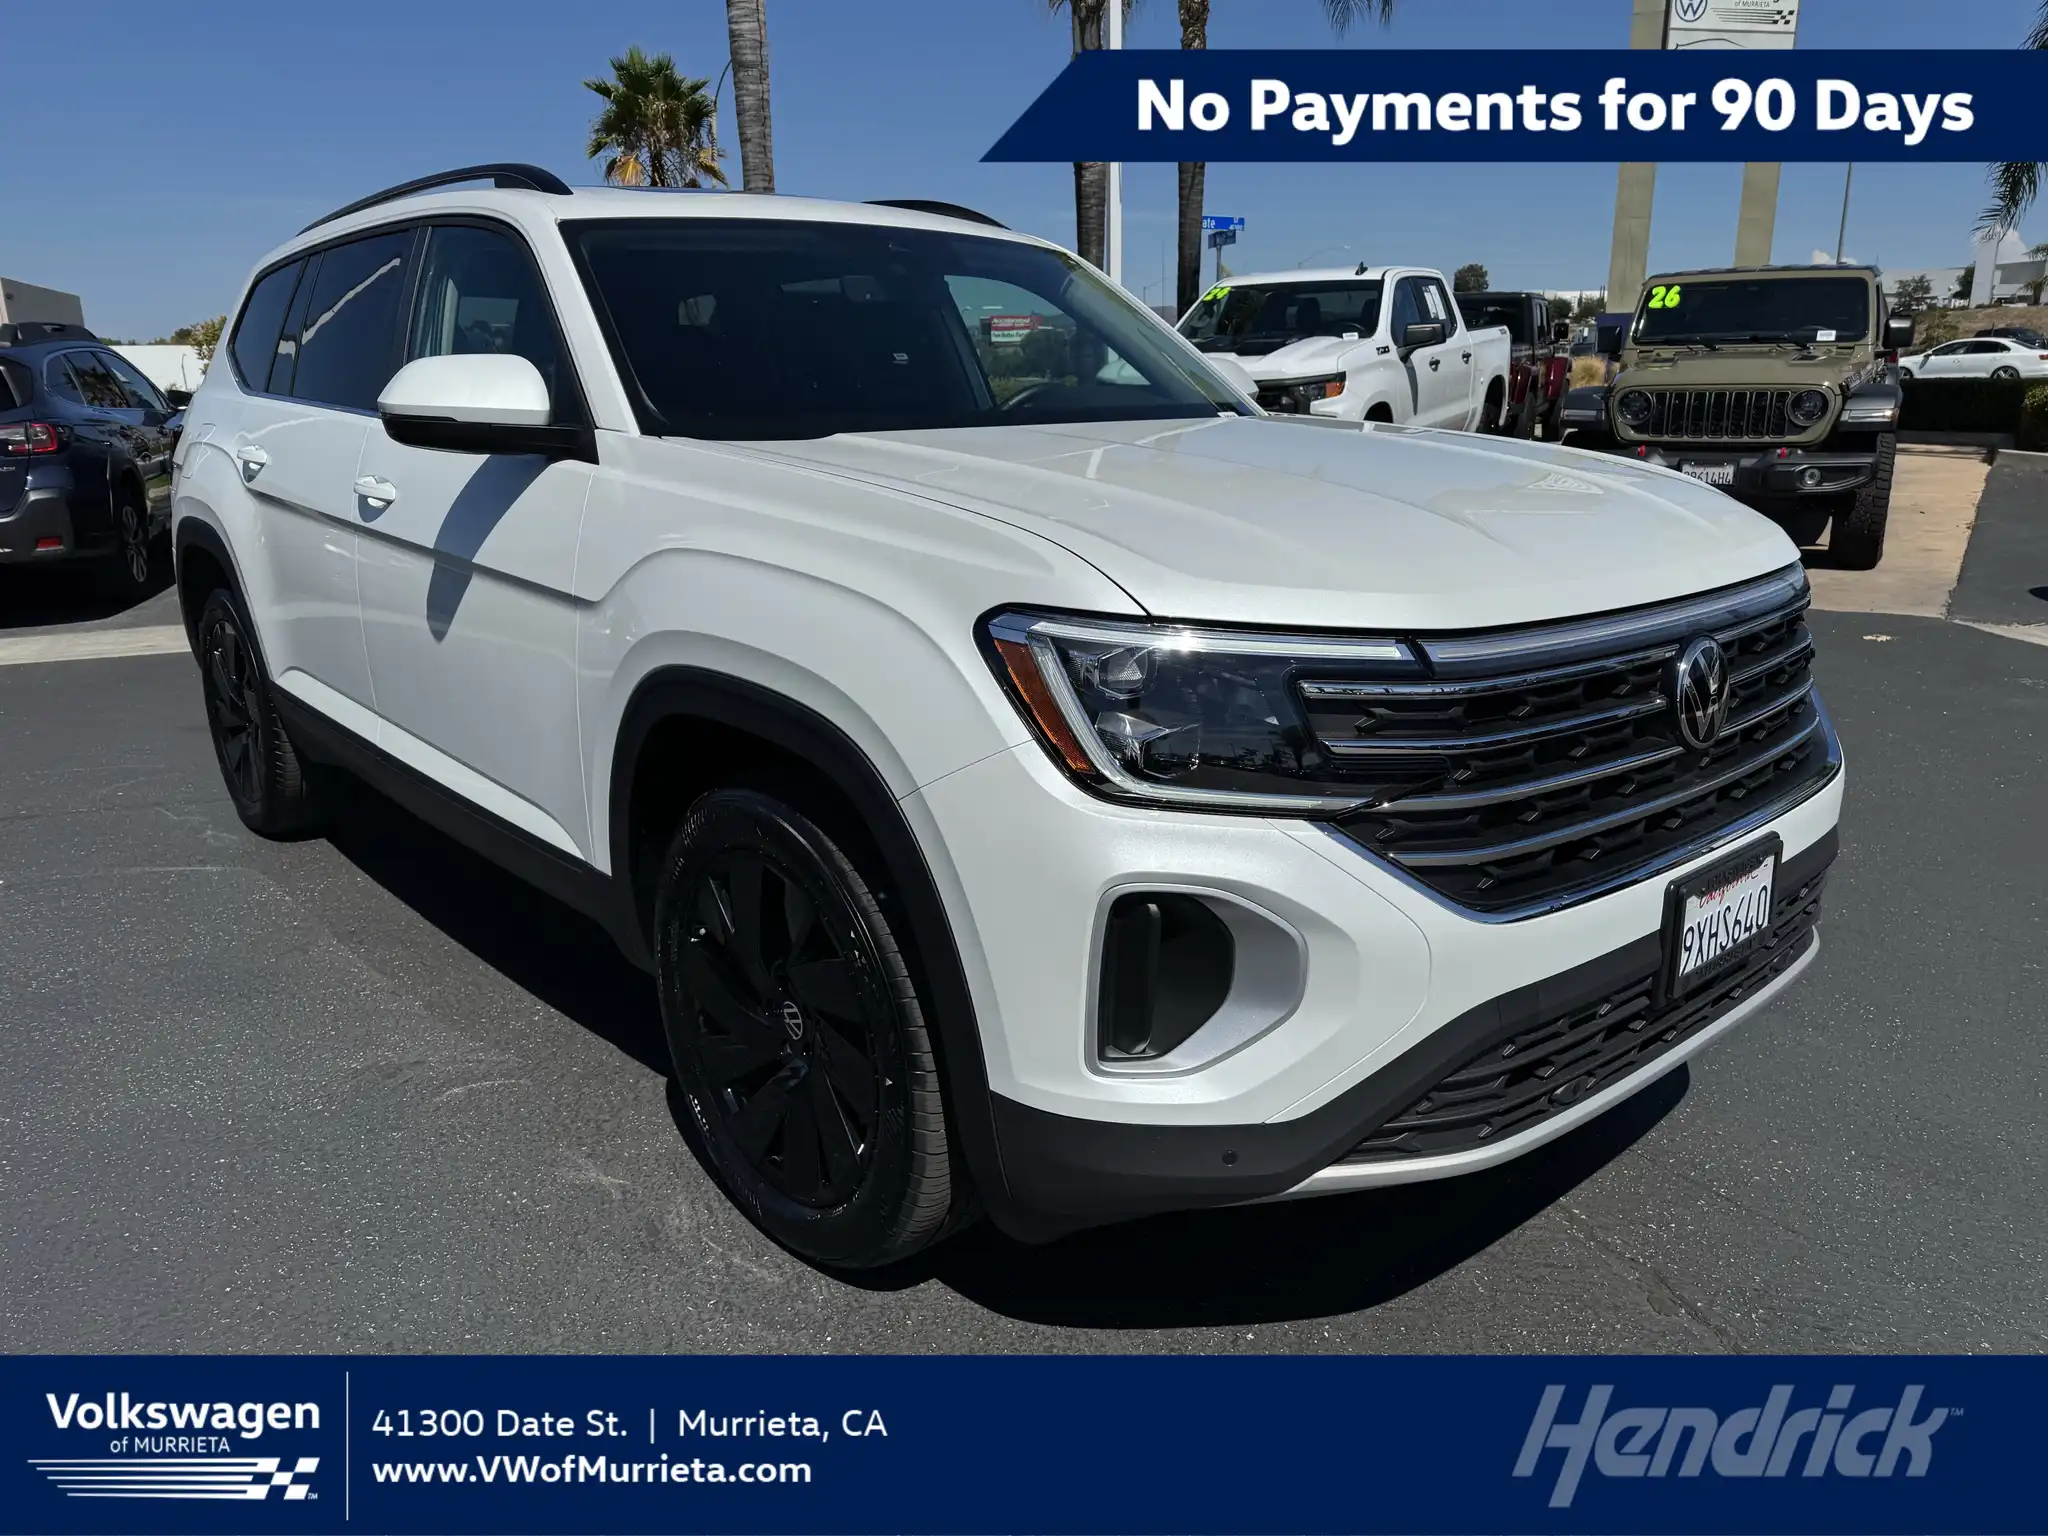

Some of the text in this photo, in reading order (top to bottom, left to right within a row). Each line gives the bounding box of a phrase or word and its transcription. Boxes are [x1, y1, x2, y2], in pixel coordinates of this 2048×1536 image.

[1202, 217, 1216, 229] ate
[1648, 285, 1681, 308] 26
[1680, 884, 1768, 976] 9XHS640
